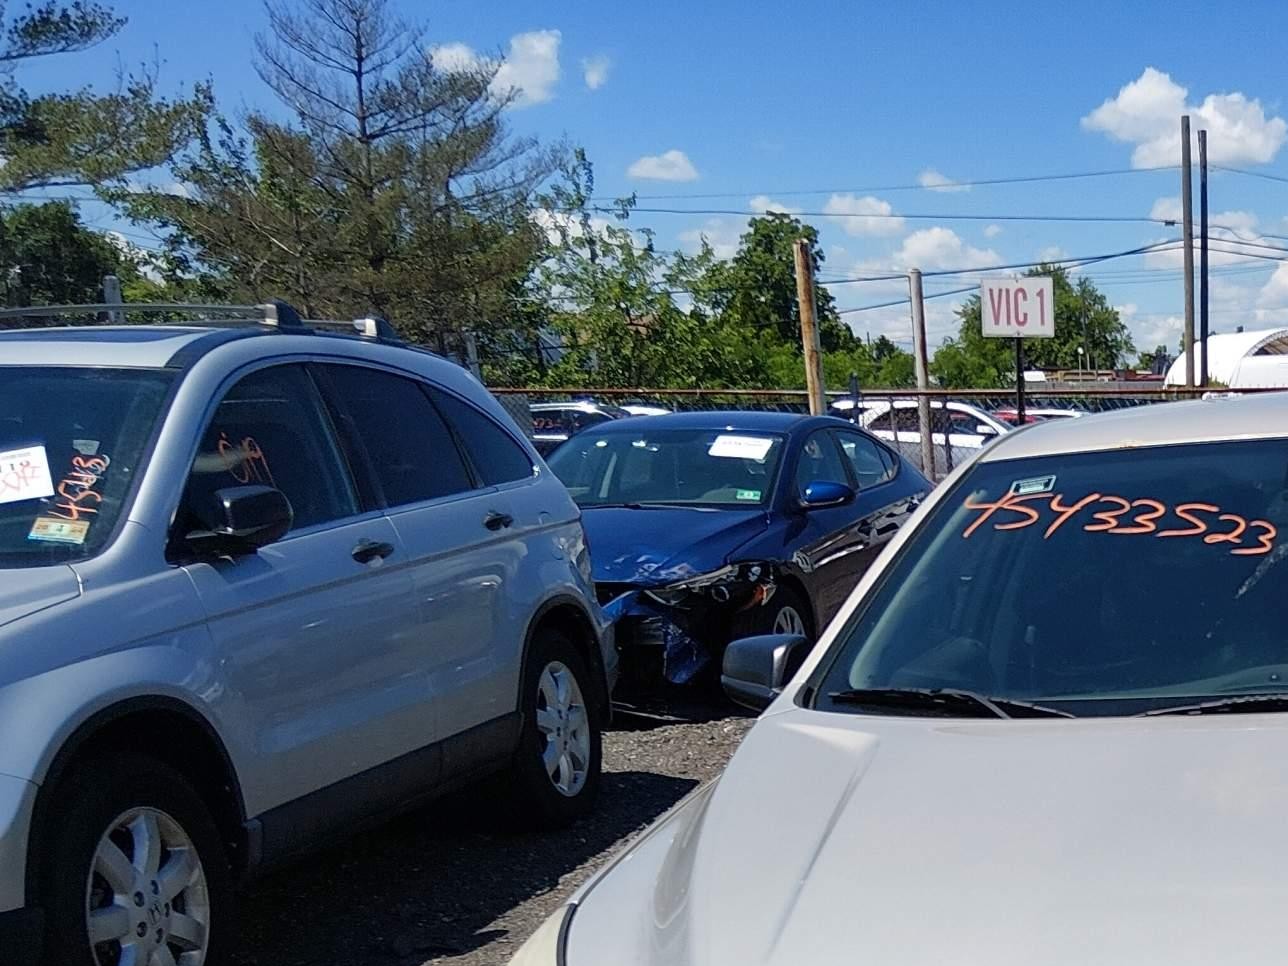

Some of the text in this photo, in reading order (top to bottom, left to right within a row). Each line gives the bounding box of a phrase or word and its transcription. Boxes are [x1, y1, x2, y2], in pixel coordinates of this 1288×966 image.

[988, 287, 1045, 327] VIC 1
[962, 491, 1278, 556] 45433523
